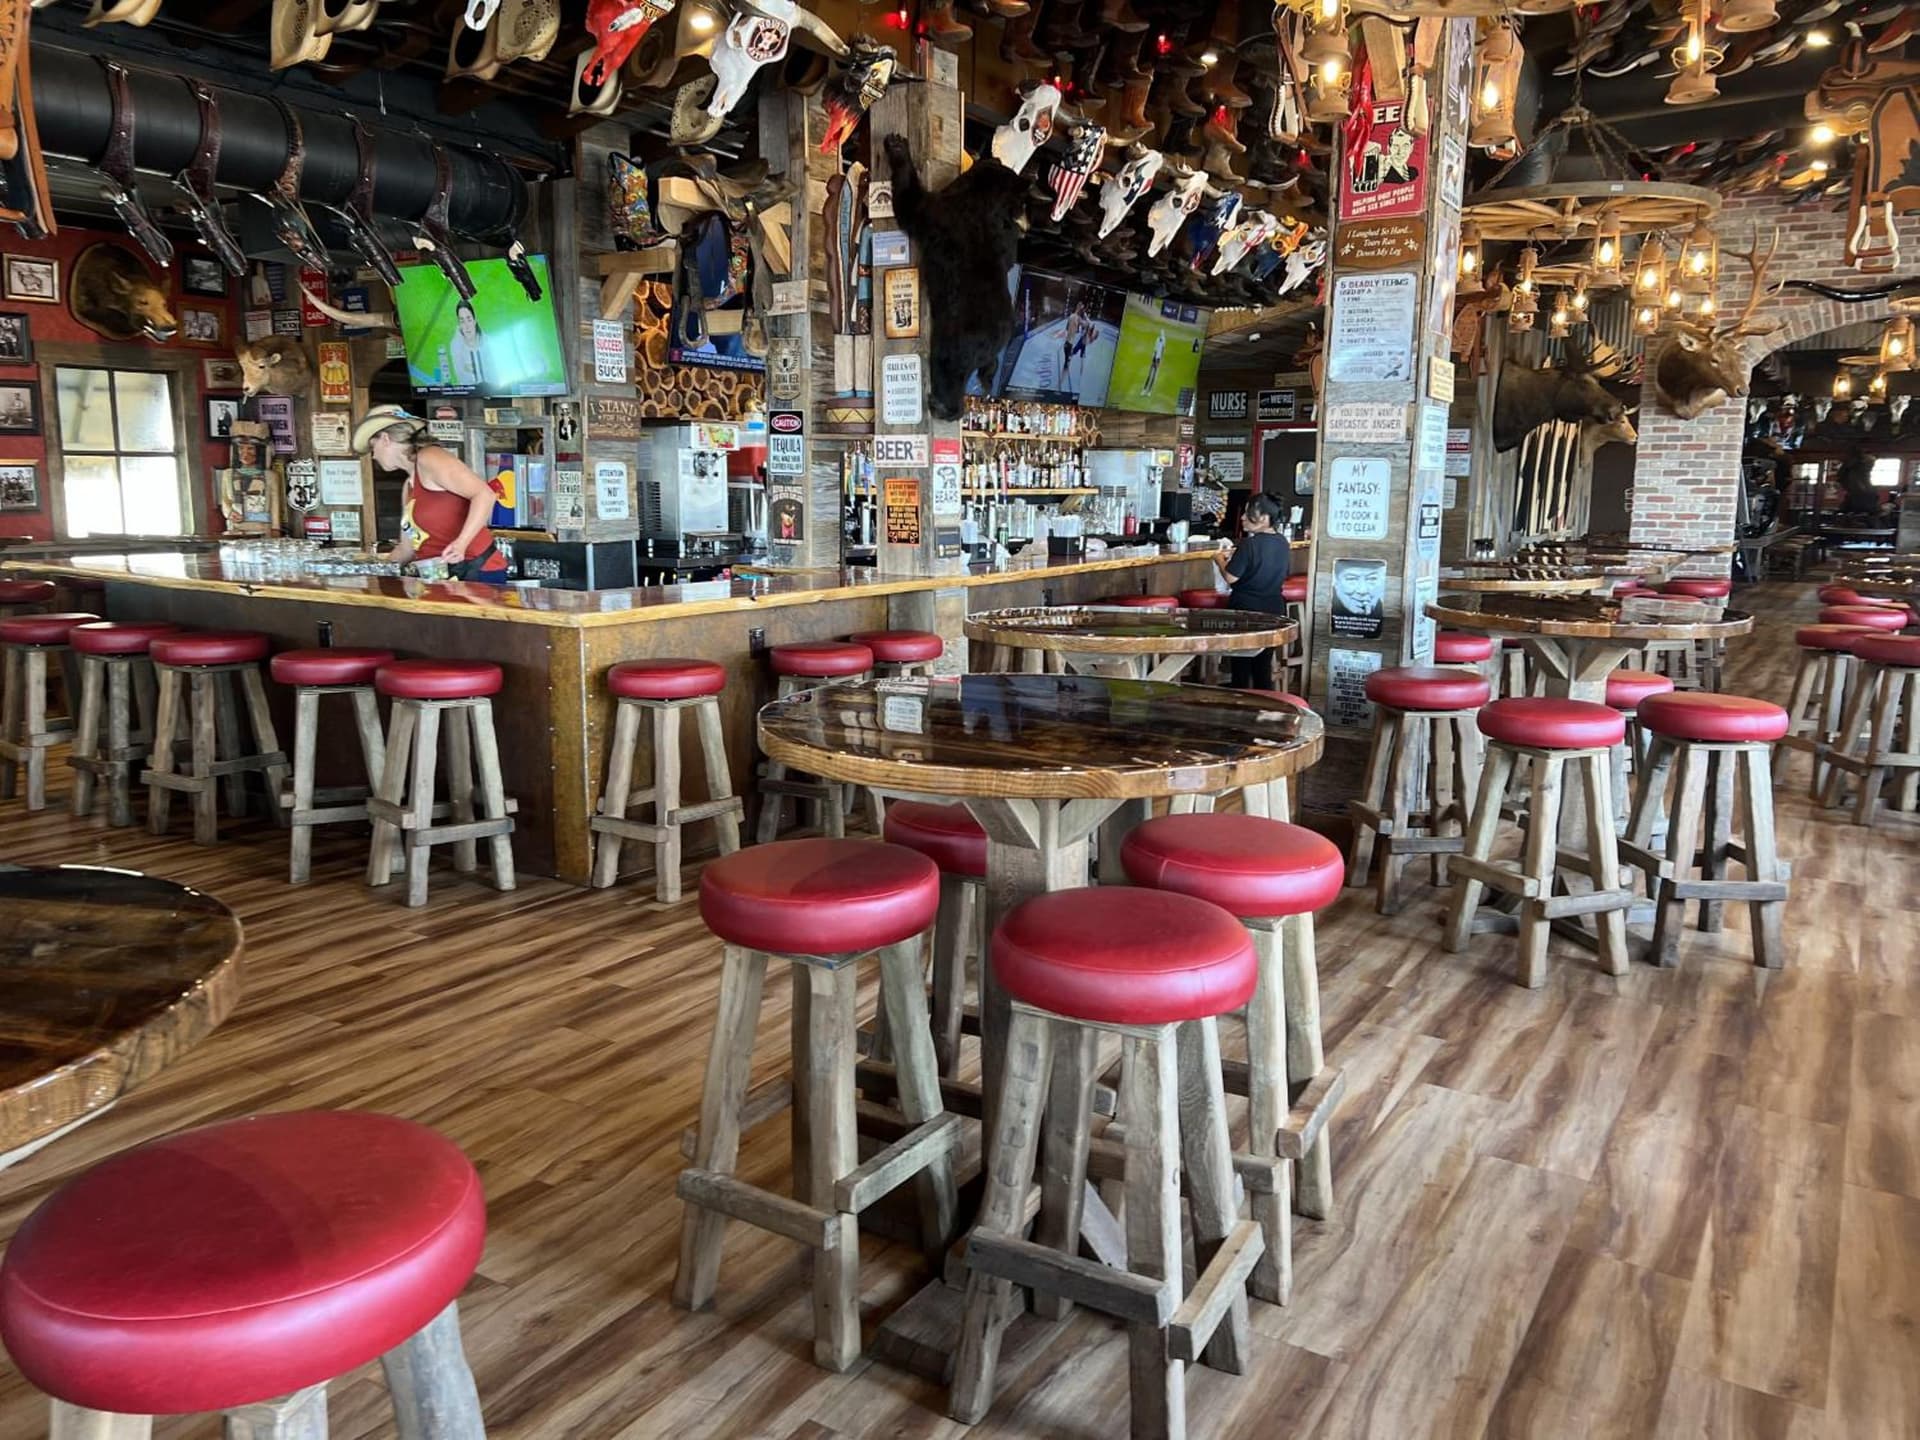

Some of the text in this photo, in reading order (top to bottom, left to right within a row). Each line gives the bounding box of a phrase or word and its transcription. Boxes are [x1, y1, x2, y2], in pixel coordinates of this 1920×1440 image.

[1373, 106, 1400, 125] EE
[1340, 278, 1409, 289] 5 DEADLY TERMS
[597, 339, 623, 352] SUCCEED
[598, 365, 624, 378] SUCK
[886, 373, 918, 382] THE WEST
[1211, 393, 1247, 411] NURSE
[1270, 394, 1293, 404] WE'RE
[598, 400, 638, 417] STAND
[1330, 408, 1336, 416] IF
[1340, 408, 1353, 417] YOU
[1355, 408, 1374, 417] DON'T
[1377, 407, 1395, 416] WANT
[1329, 419, 1401, 430] SARCASTIC ANSWER
[772, 437, 801, 453] TEQUILA
[876, 440, 914, 461] BEER
[1351, 463, 1369, 478] MY
[1337, 482, 1381, 495] FANTASY:
[1339, 511, 1349, 519] TO
[1351, 511, 1371, 520] COOK
[1342, 523, 1352, 532] TO
